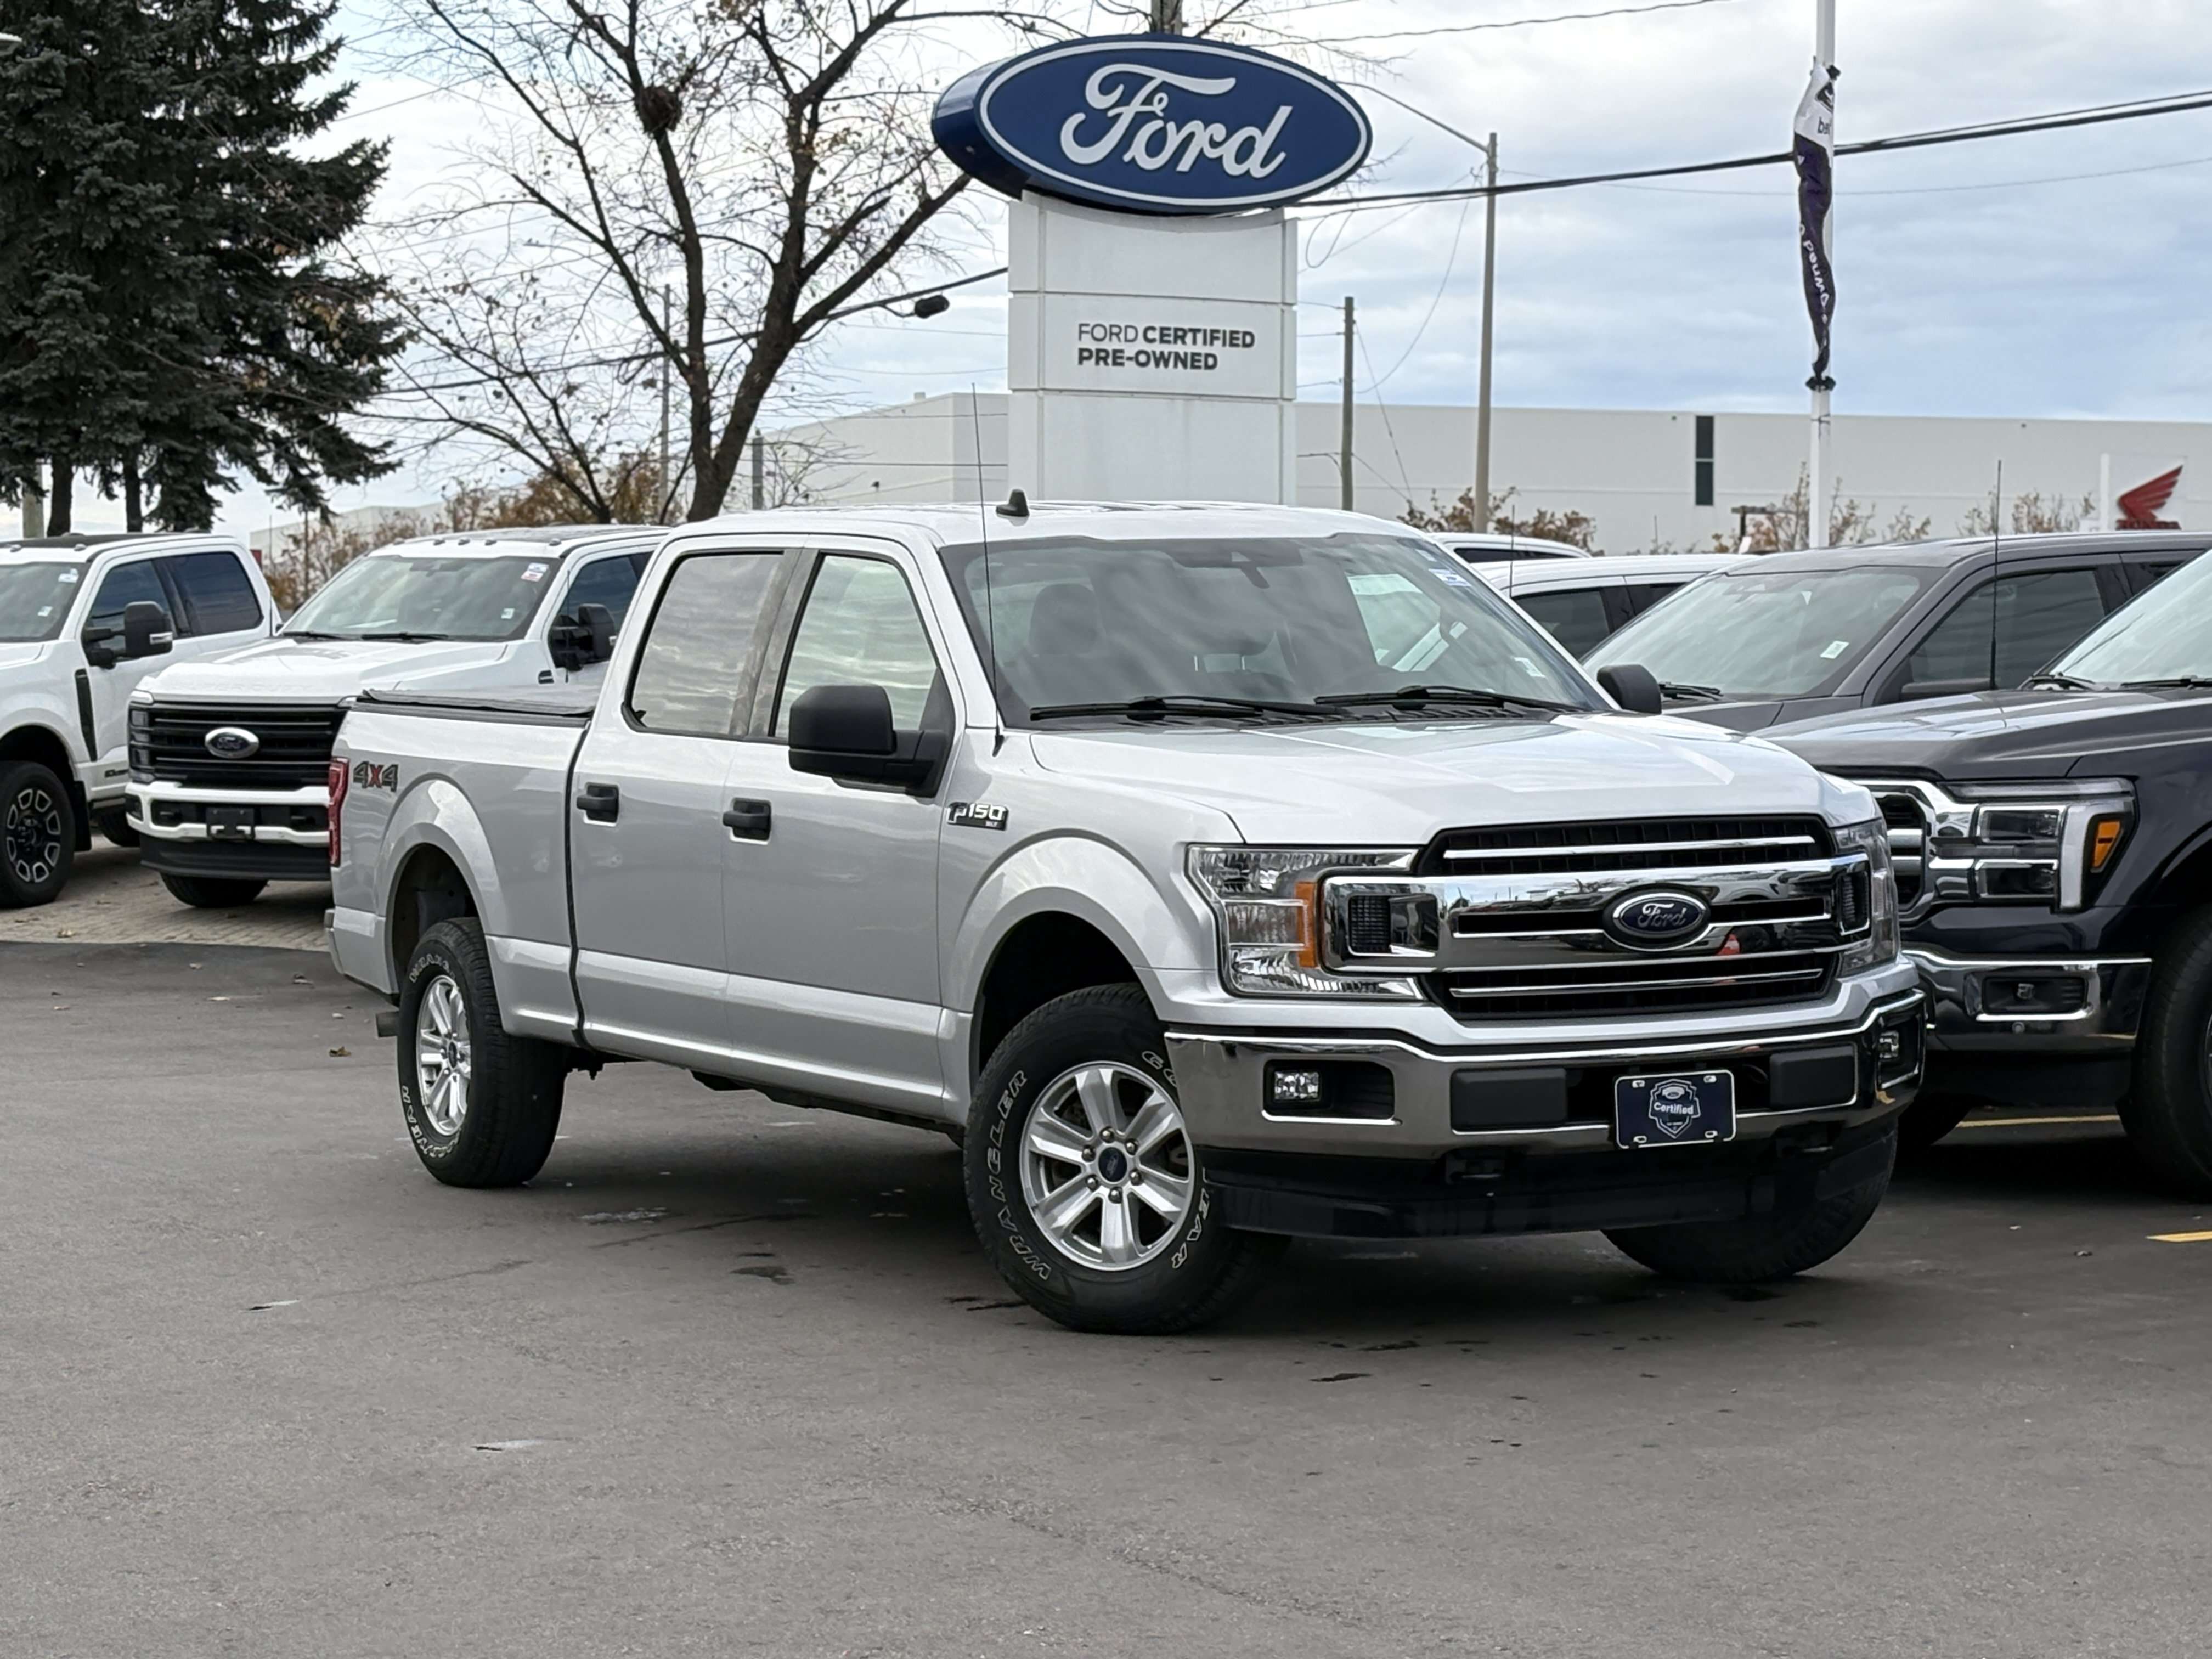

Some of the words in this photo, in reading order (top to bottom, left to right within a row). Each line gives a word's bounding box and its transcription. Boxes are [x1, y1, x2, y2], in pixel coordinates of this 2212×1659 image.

[1060, 63, 1293, 179] Ford
[1079, 324, 1138, 343] FORD
[1143, 326, 1255, 348] CERTIFIED
[1078, 347, 1218, 370] PRE-OWNED
[1637, 902, 1687, 928] Ford
[1654, 1102, 1694, 1115] Certified
[986, 1069, 1052, 1281] WRANGLER
